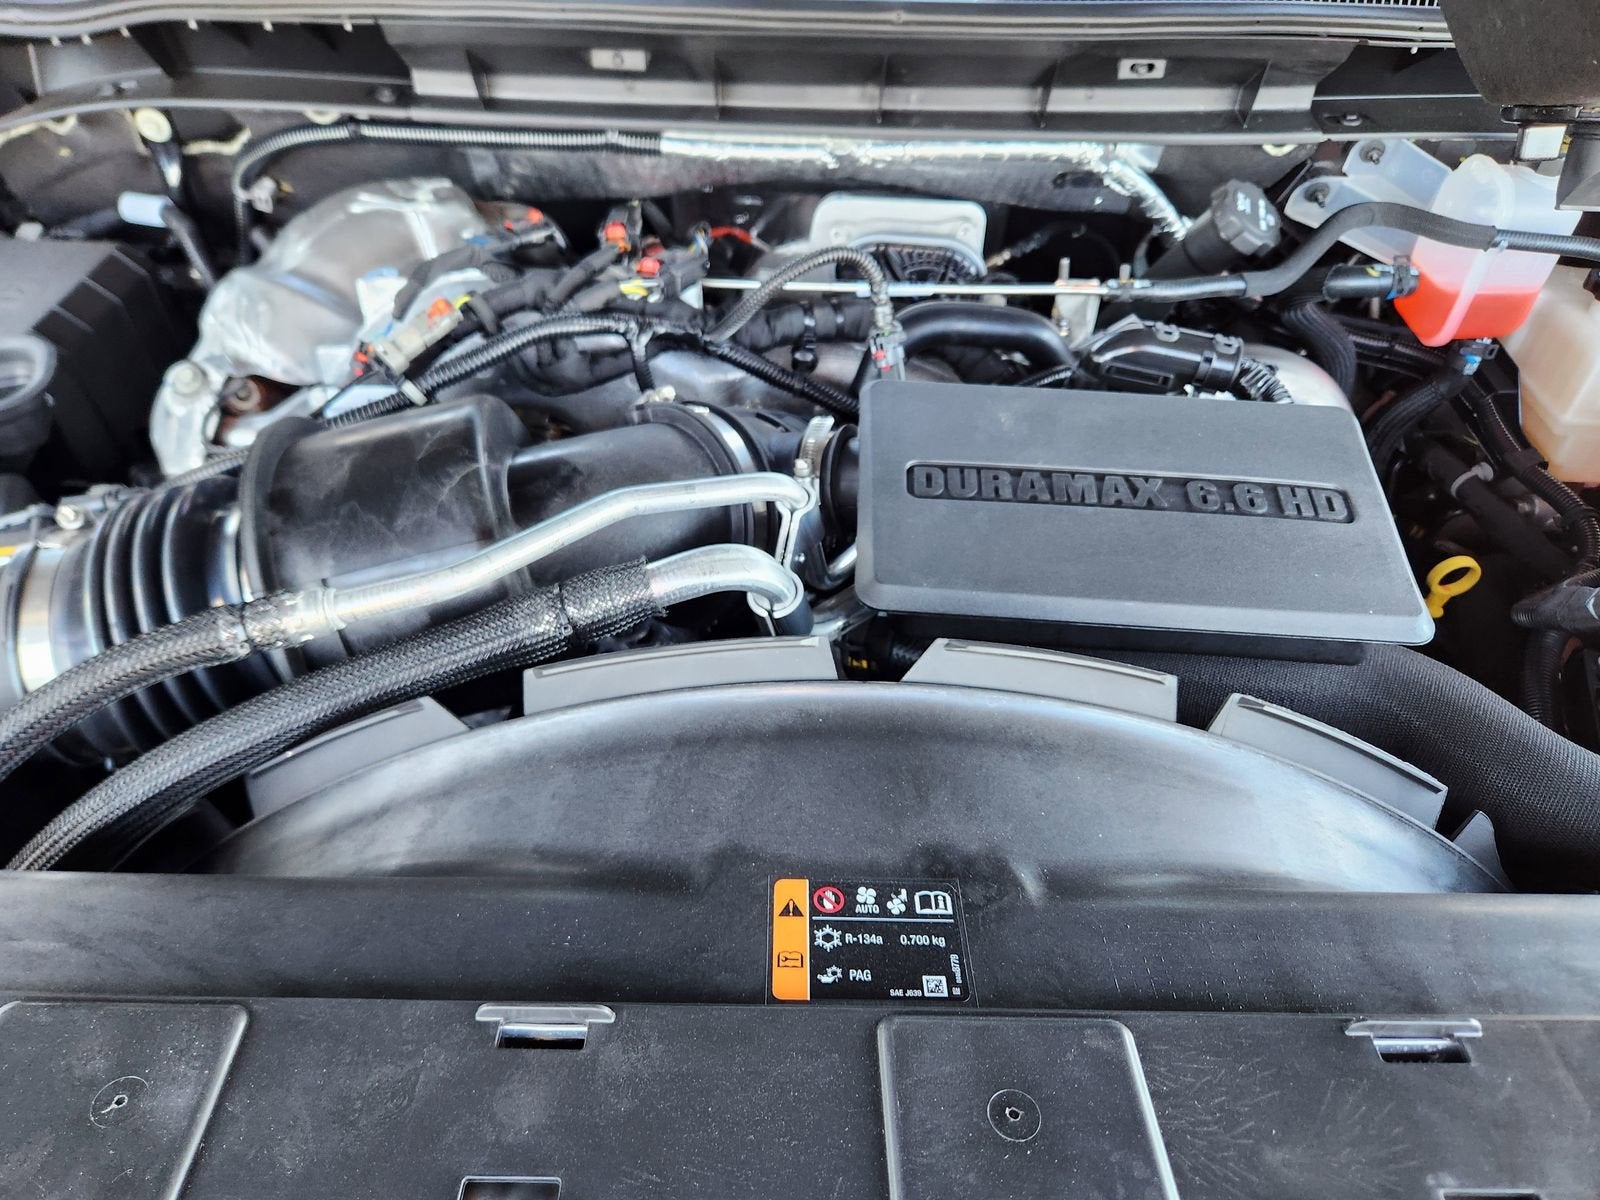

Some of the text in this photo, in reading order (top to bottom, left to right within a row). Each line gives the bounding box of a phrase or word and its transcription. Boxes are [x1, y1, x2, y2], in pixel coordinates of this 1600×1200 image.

[912, 466, 1349, 521] DURAMAX 6.6 HD
[855, 903, 880, 914] AUTO
[845, 933, 946, 948] R-134a 0.700 kg
[849, 969, 872, 981] PAG
[889, 988, 904, 997] SAE
